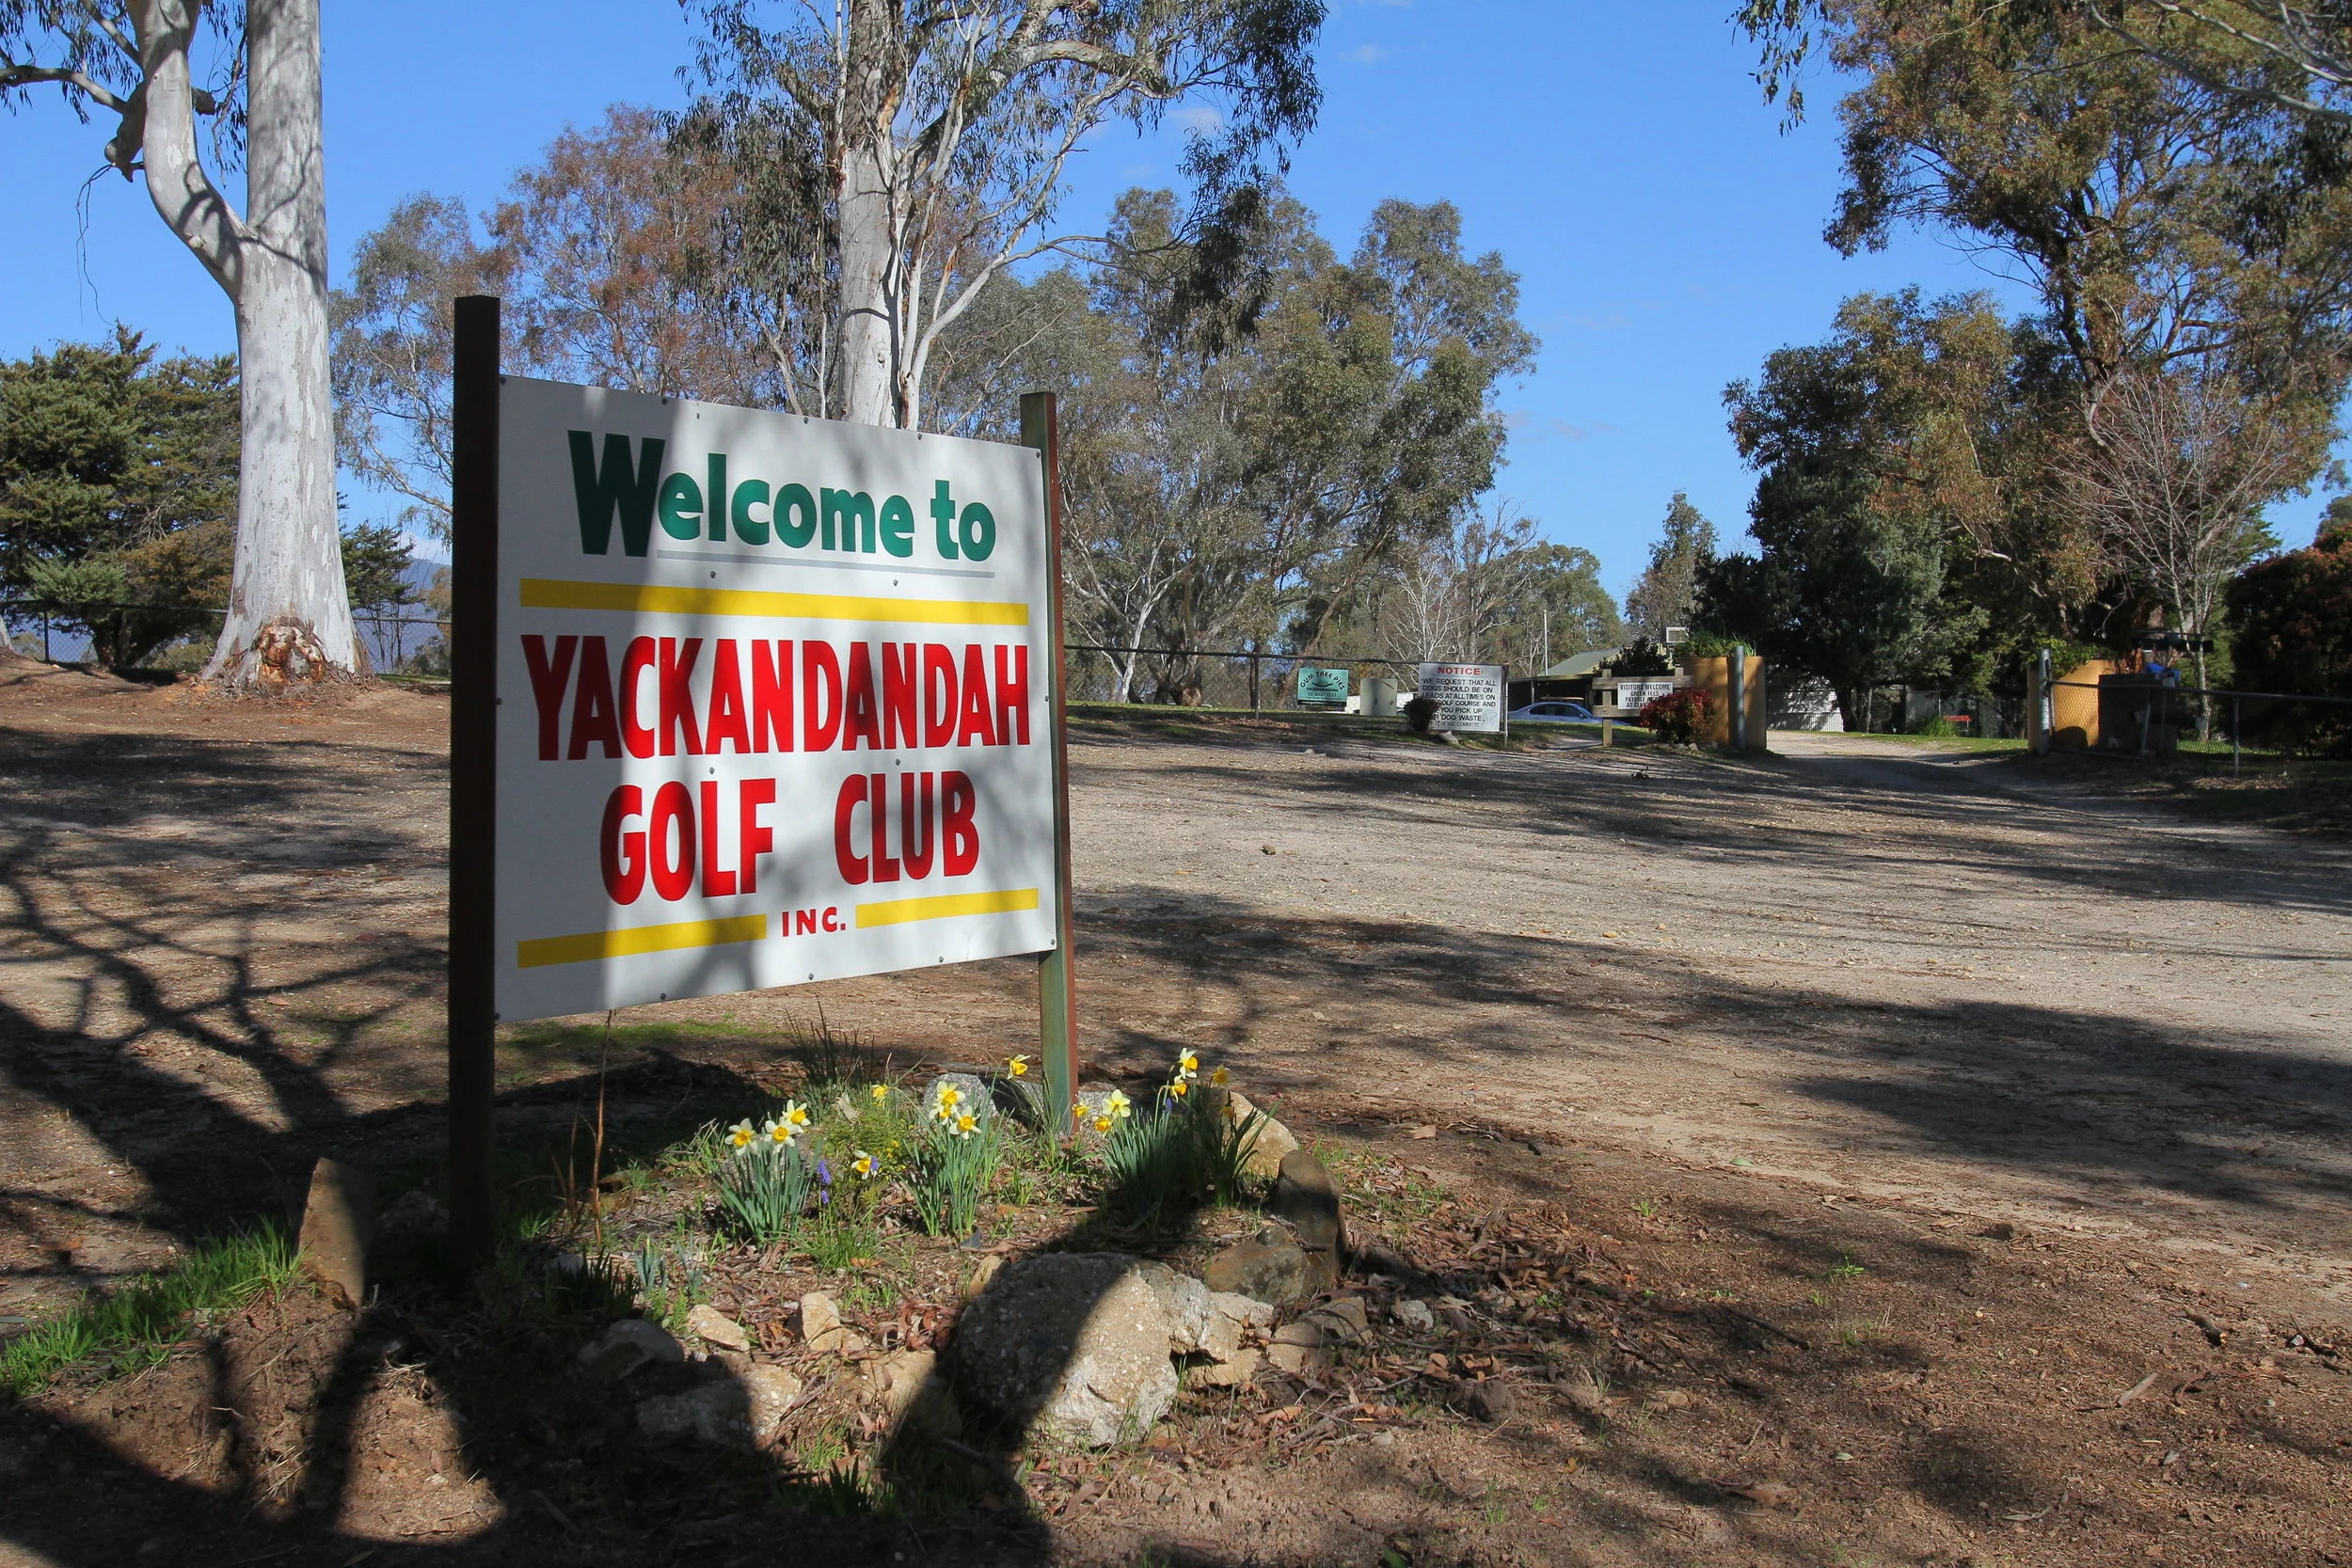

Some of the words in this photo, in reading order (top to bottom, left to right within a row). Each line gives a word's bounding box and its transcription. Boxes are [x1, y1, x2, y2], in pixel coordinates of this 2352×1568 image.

[567, 429, 914, 558] Welcome
[930, 479, 996, 562] to
[520, 634, 1031, 761] YACKANDANDAH
[1300, 673, 1314, 688] GUM
[1333, 676, 1345, 690] PIES
[599, 777, 776, 906] GOLF
[834, 769, 980, 885] CLUB
[781, 906, 847, 937] INC.
